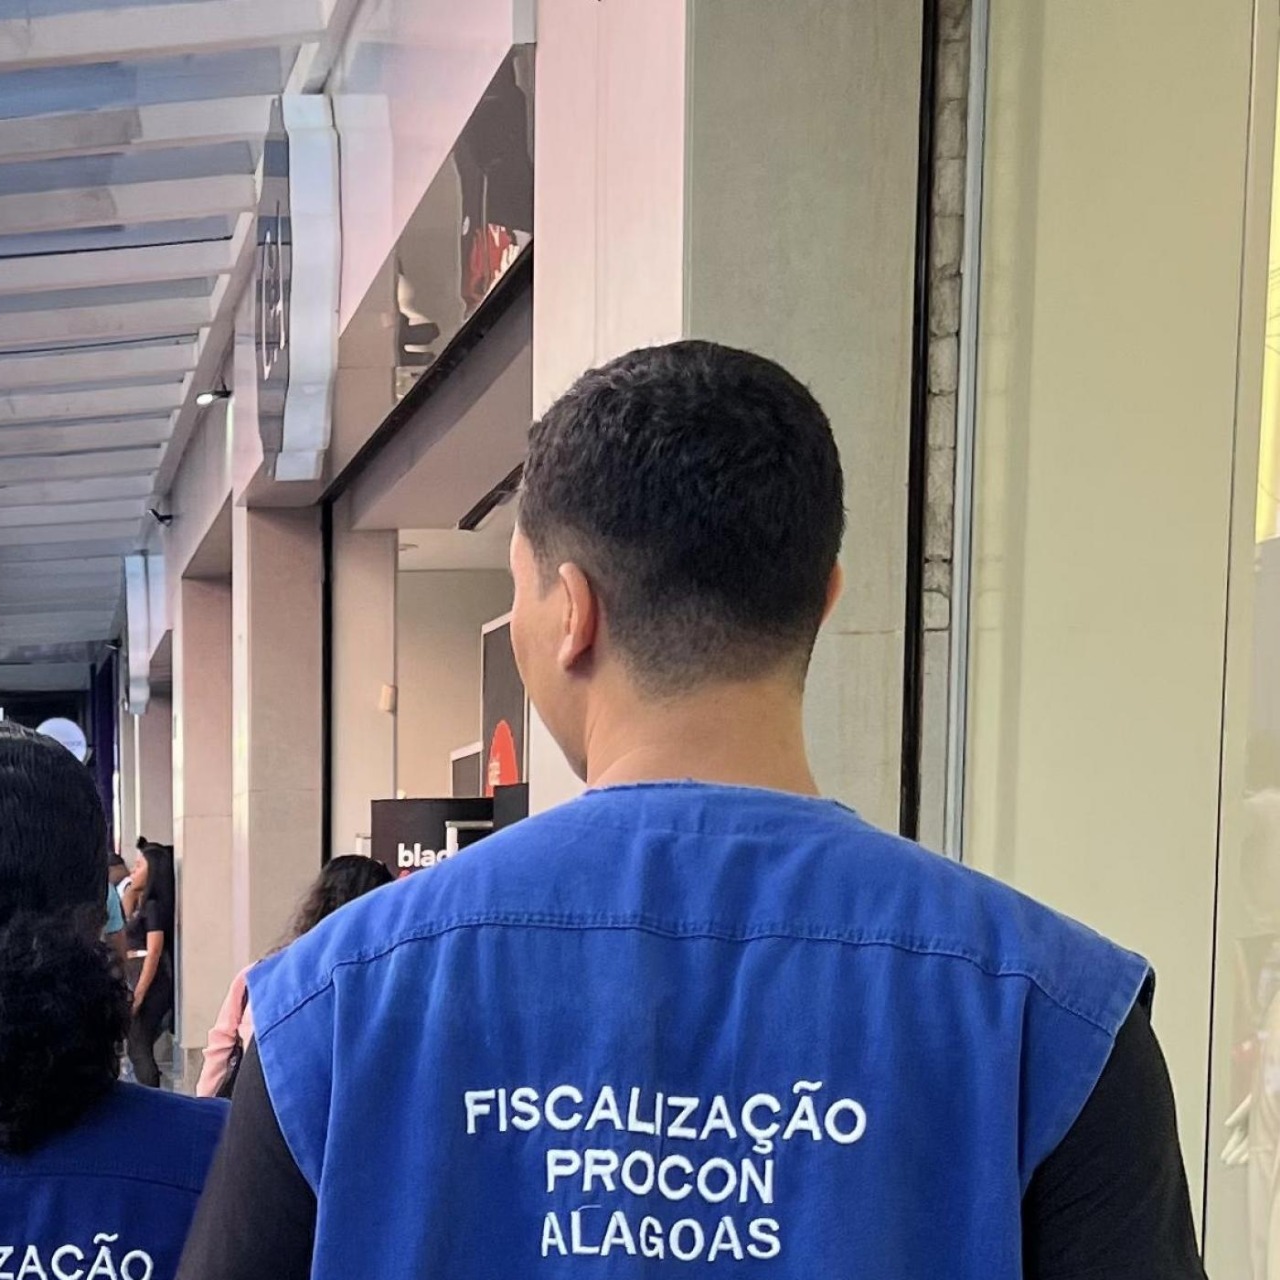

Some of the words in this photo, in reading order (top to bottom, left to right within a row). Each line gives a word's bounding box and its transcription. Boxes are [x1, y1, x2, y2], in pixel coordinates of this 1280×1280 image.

[464, 1080, 867, 1154] FISCALIZAÇÃO
[546, 1148, 774, 1204] PROCON
[541, 1210, 781, 1261] ALAGOAS
